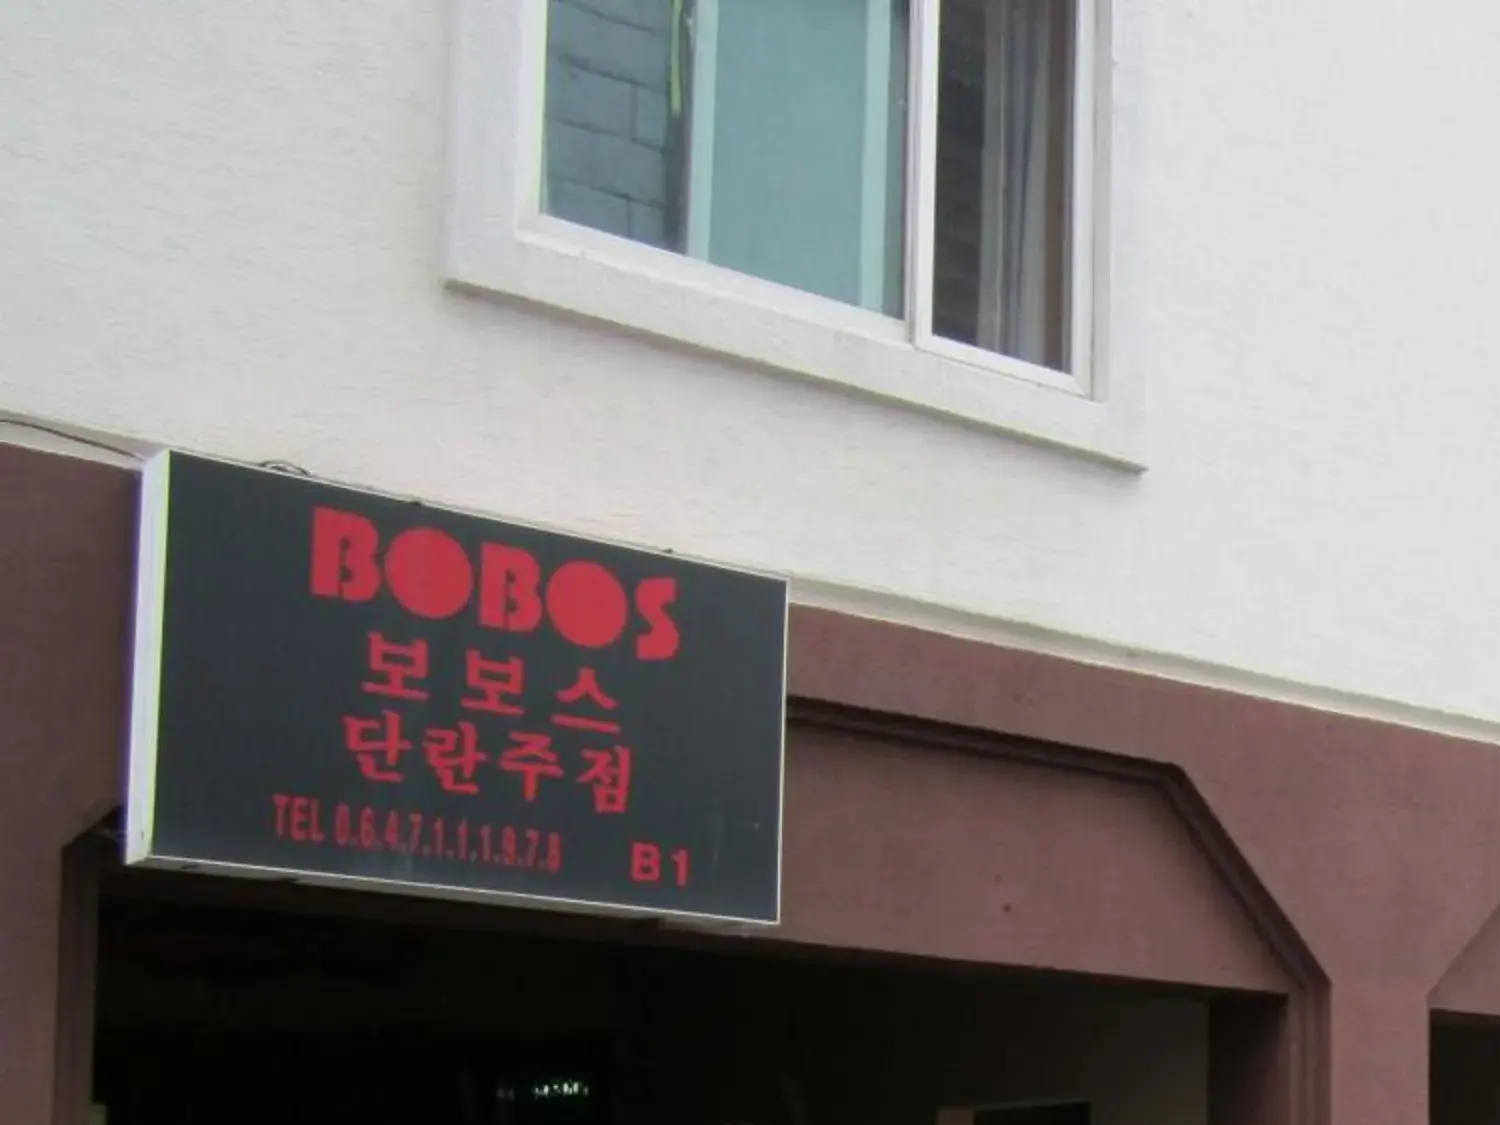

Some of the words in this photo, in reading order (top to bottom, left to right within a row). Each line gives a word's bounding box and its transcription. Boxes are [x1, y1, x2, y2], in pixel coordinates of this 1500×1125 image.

[309, 506, 681, 661] BOBOS
[362, 631, 621, 733] 보보스
[343, 710, 632, 813] 단란주점
[272, 794, 325, 842] TEL
[630, 842, 691, 886] B1
